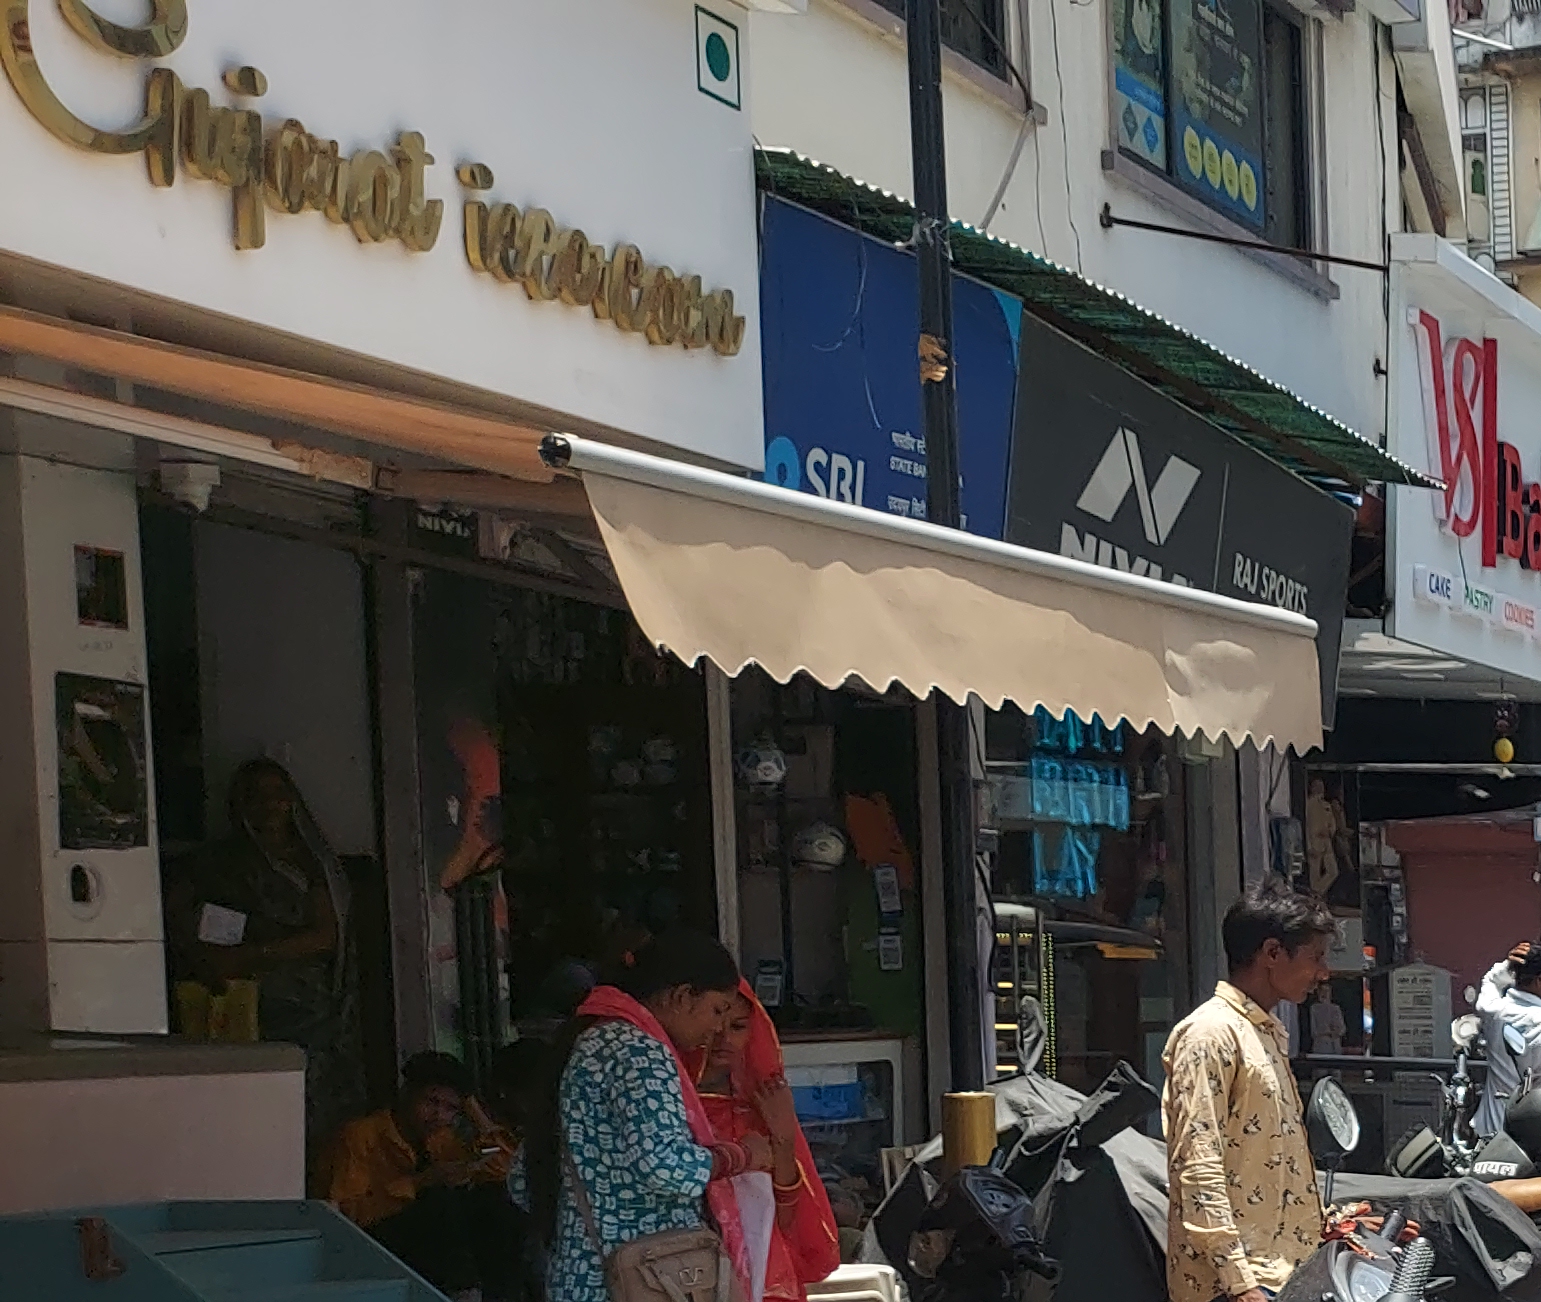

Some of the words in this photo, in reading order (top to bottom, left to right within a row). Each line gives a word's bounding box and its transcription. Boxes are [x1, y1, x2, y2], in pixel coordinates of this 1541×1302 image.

[1233, 552, 1260, 595] RAJ
[1261, 565, 1308, 615] SPORTS
[1429, 572, 1450, 600] CAKE
